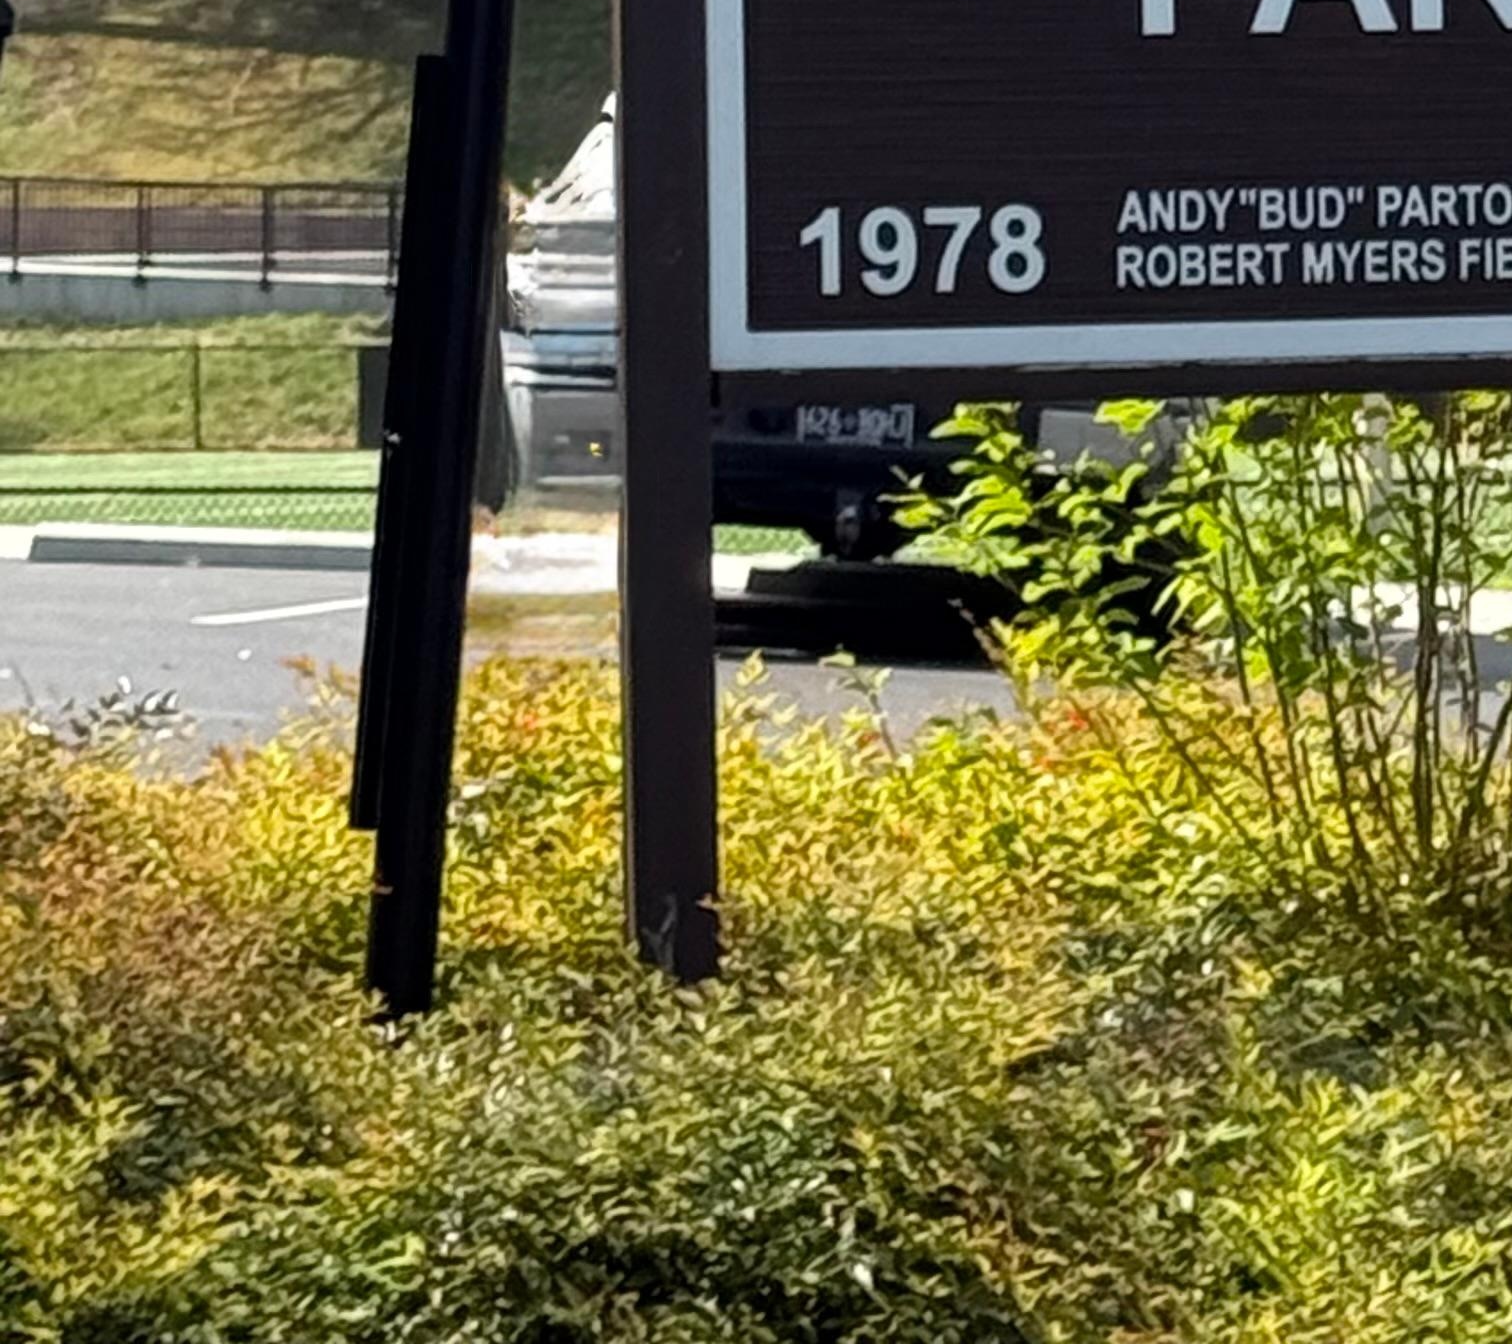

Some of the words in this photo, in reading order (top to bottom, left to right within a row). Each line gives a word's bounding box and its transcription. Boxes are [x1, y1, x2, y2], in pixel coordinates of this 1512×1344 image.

[800, 204, 1045, 295] 1978
[1117, 242, 1290, 287] ROBERT
[1302, 239, 1446, 283] MYERS
